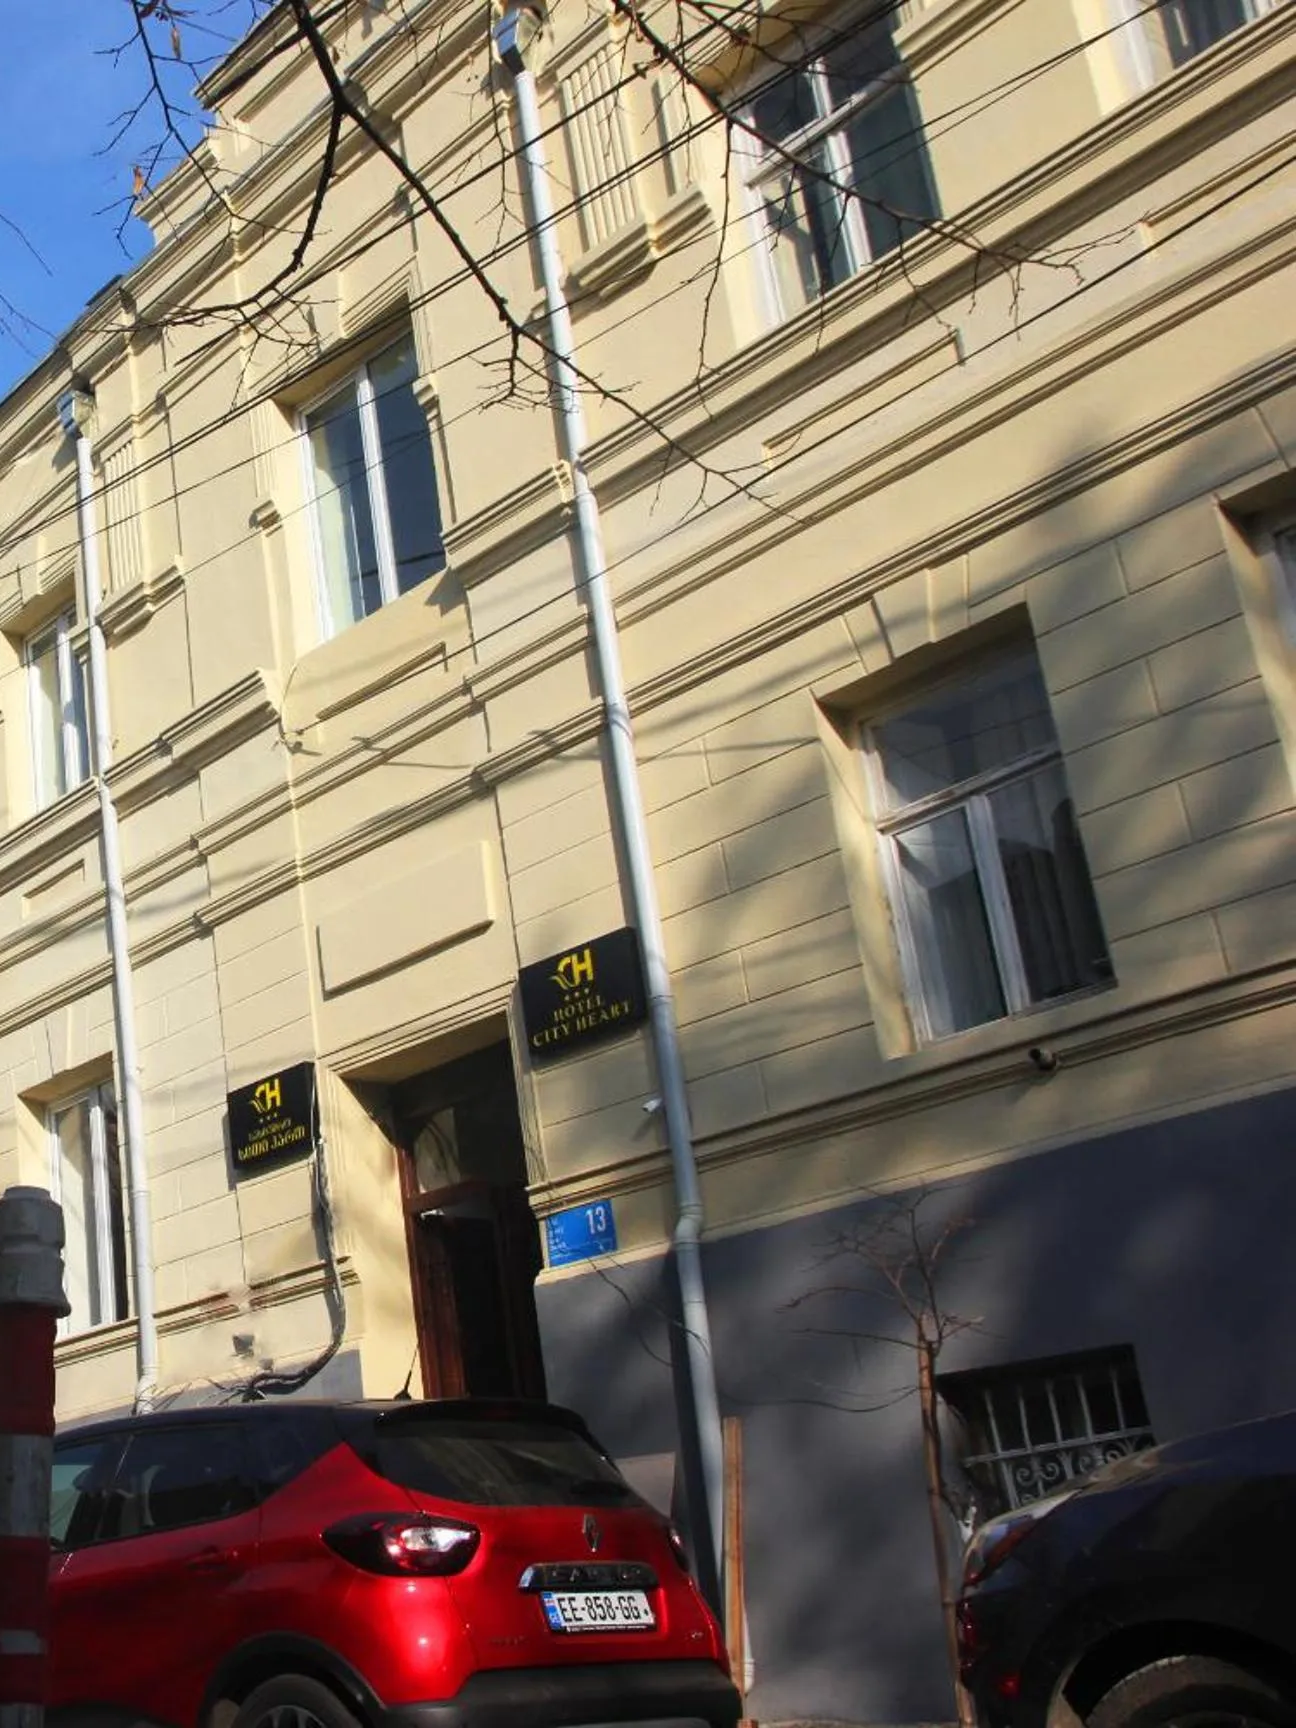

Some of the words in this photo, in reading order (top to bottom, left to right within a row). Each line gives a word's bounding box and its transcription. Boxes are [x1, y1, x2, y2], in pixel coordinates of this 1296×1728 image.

[553, 995, 602, 1021] HOTEL
[532, 1023, 571, 1047] CITY
[575, 1001, 631, 1031] HEART
[585, 1205, 607, 1235] 13
[557, 1595, 641, 1623] EE-858-GG
